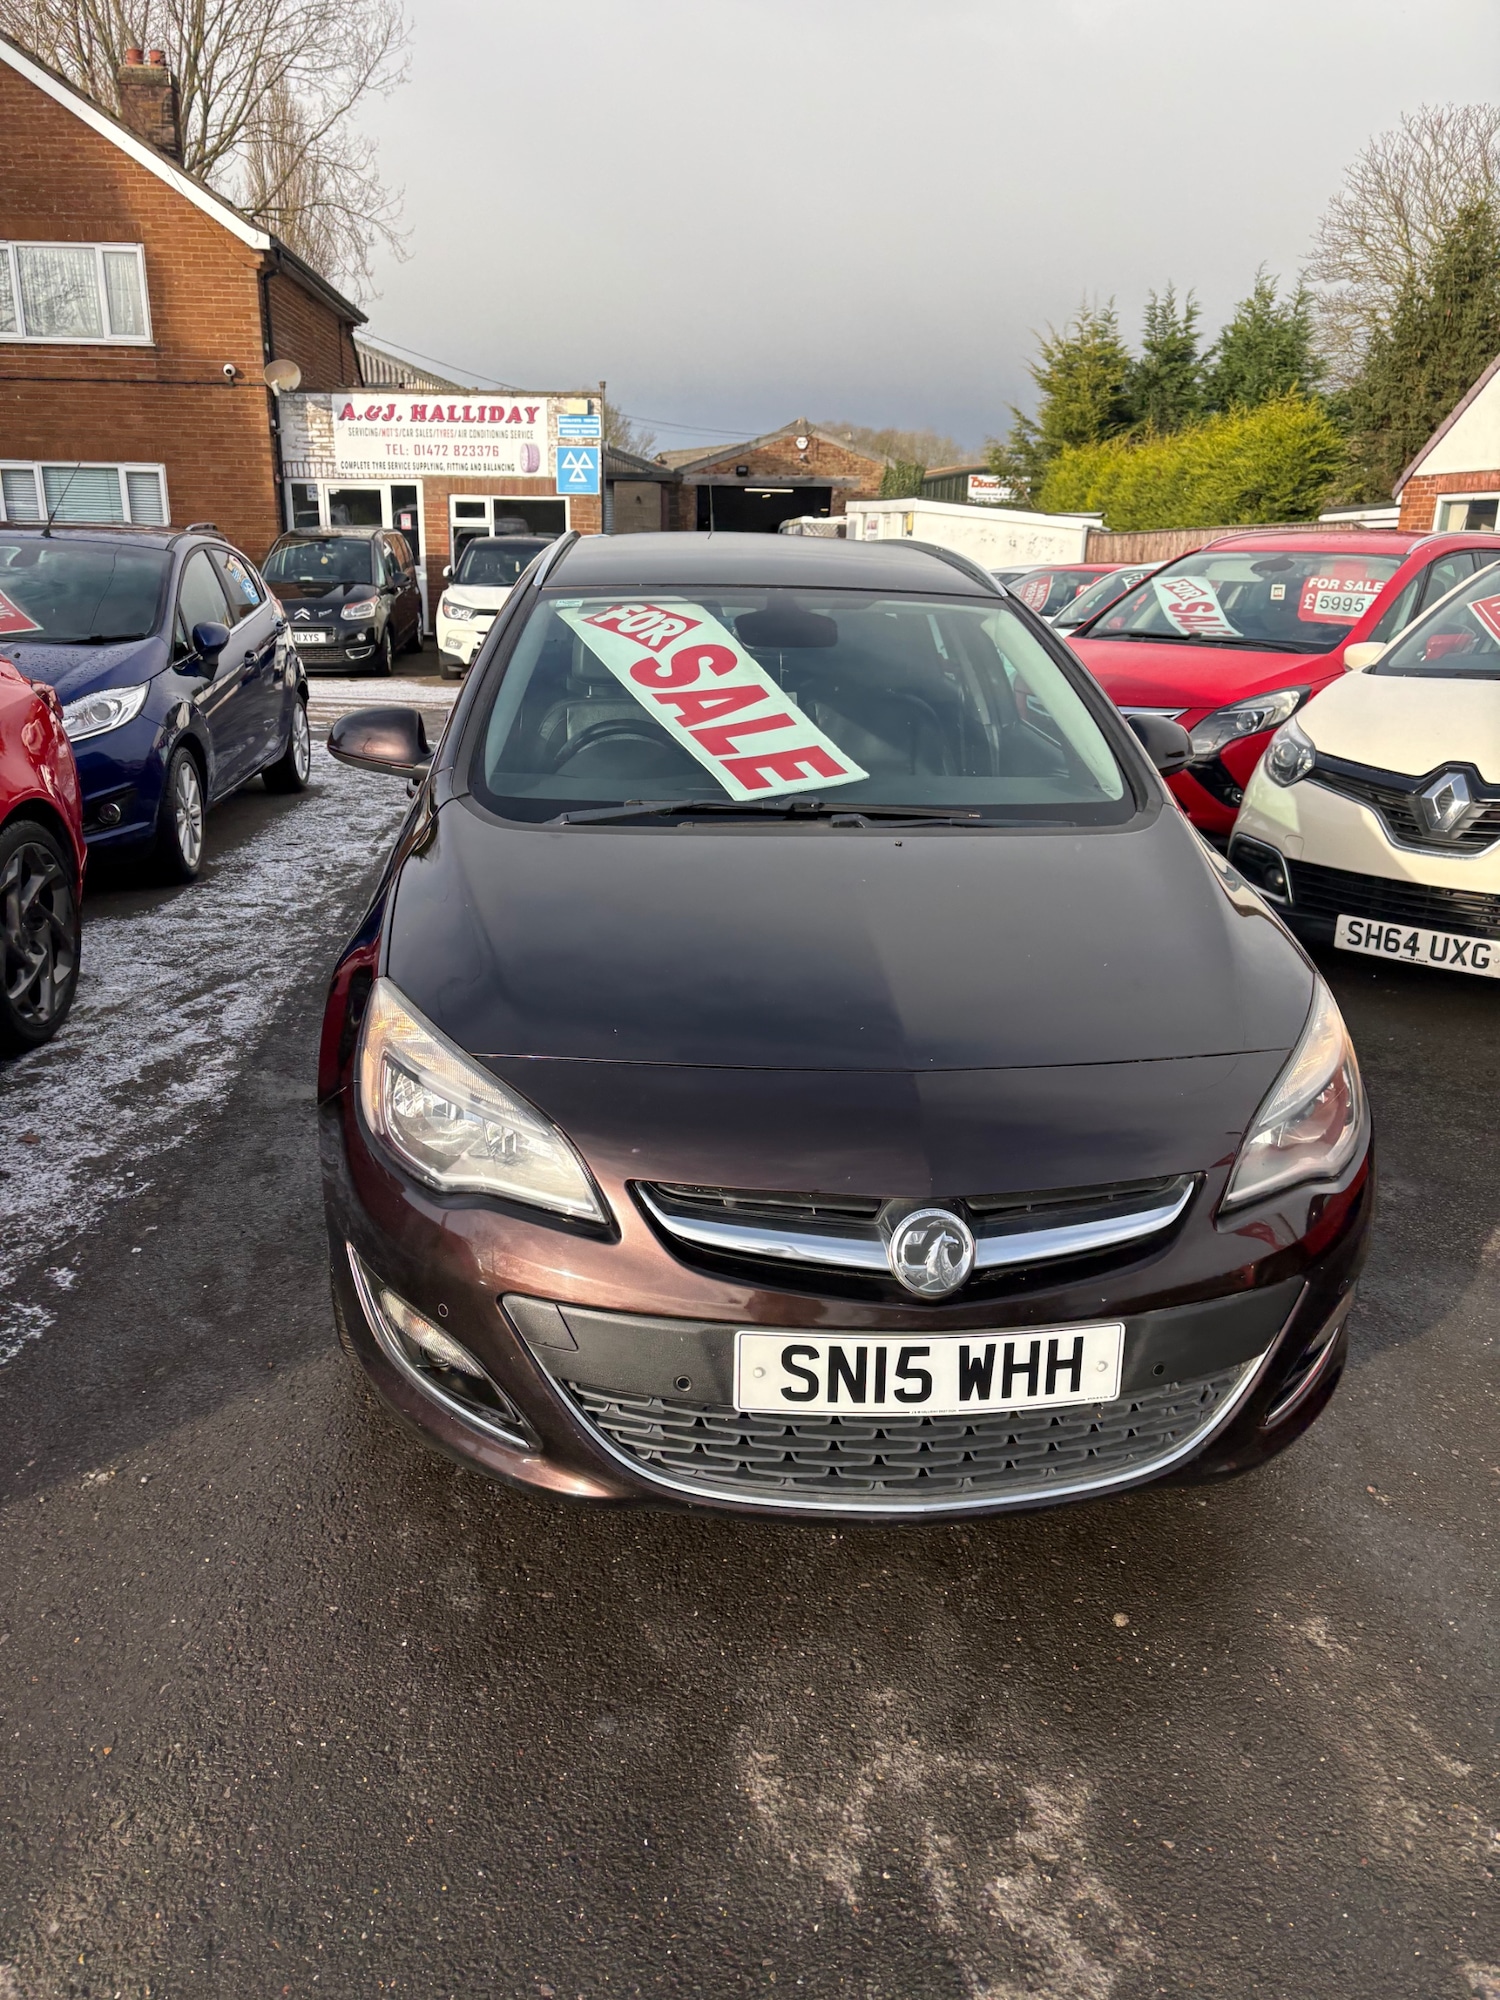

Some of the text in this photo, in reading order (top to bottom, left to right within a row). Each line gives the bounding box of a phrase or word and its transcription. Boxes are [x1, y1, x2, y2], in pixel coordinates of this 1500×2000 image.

[410, 404, 540, 424] HALLIDAY
[469, 429, 508, 439] CONDITIONING
[510, 430, 534, 439] SERVICE
[385, 443, 499, 457] TEL: 01472 823376
[340, 461, 370, 470] COMPLETE
[372, 461, 386, 470] TYRE
[387, 461, 411, 470] SERVICE
[447, 462, 468, 471] FITTING
[470, 462, 481, 471] AND
[483, 463, 515, 472] BALANCING
[1165, 580, 1202, 600] FOR
[1307, 577, 1385, 592] FOR SALE
[302, 633, 320, 642] XYS
[594, 605, 848, 790] FOR SALE
[1346, 920, 1492, 969] SH64 UXG
[780, 1336, 1084, 1404] SN15 WHH
